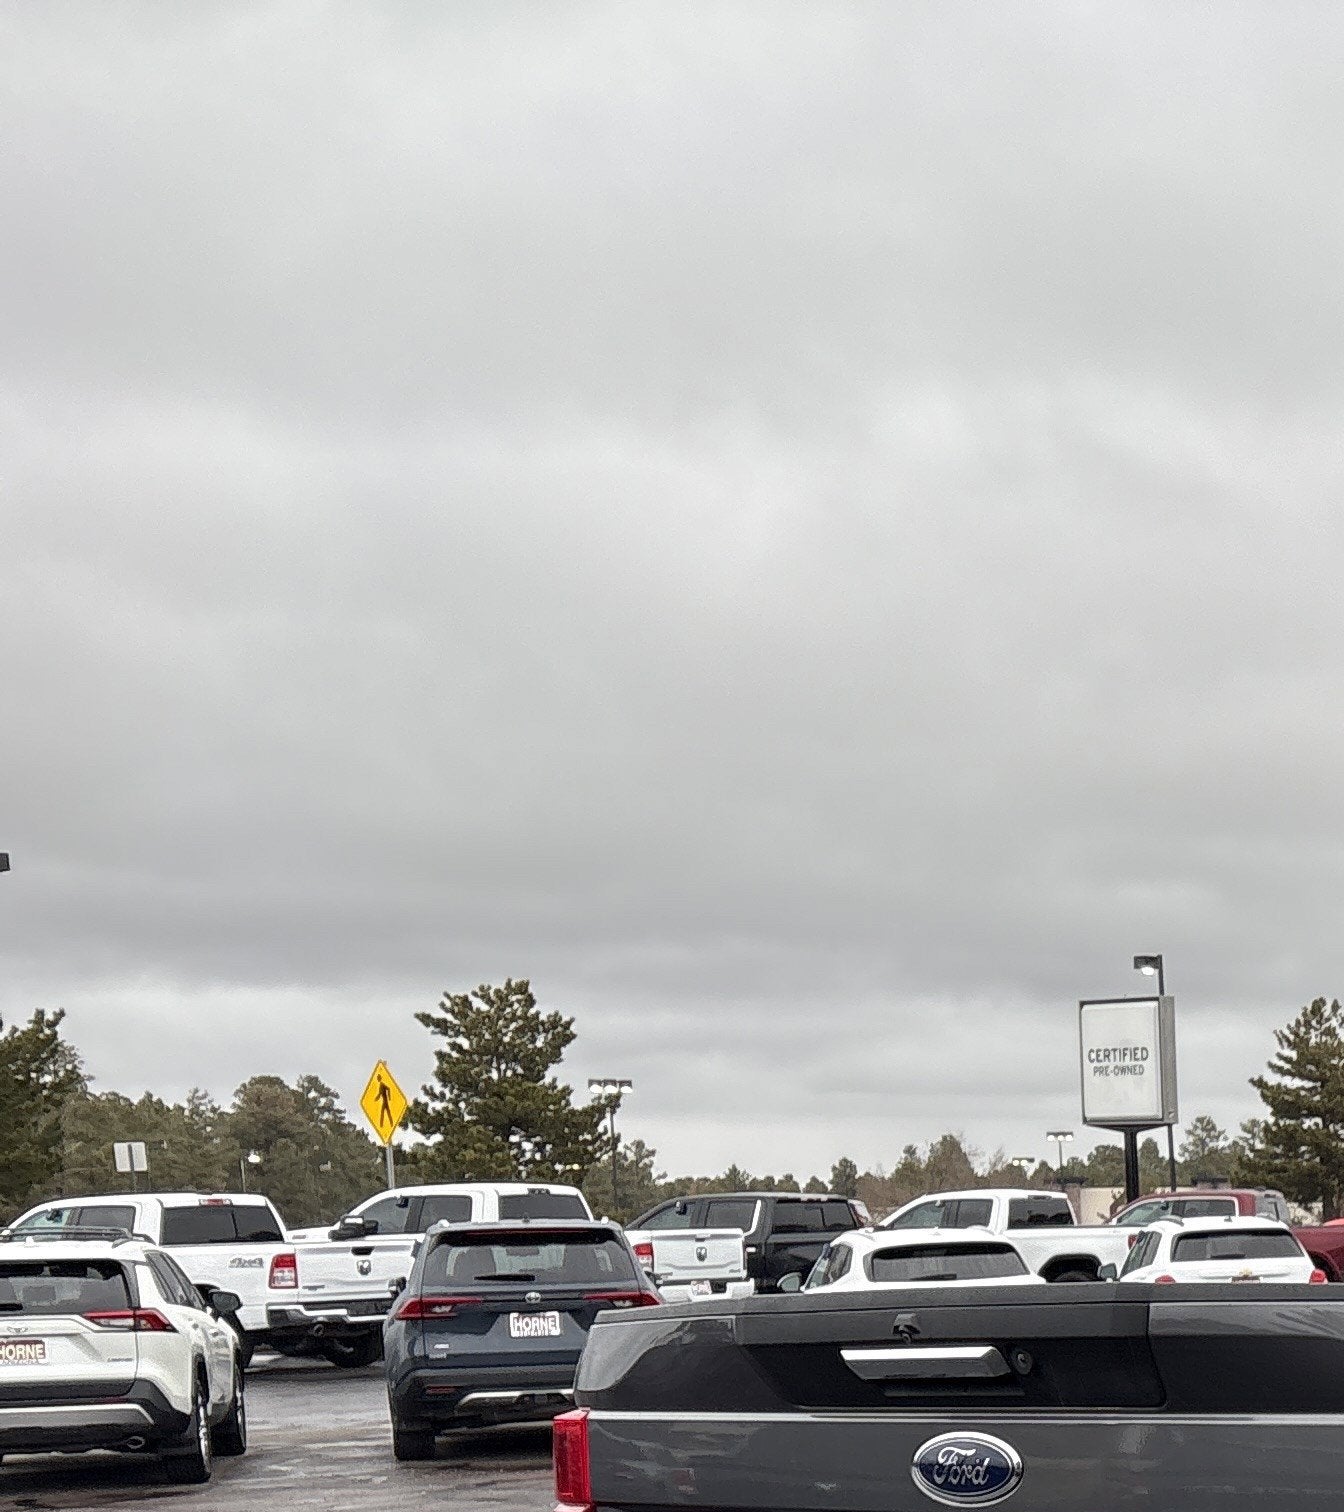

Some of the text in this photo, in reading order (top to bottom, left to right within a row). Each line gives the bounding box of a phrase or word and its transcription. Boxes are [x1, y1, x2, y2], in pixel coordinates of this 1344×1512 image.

[1088, 1046, 1149, 1063] CERTIFIED
[1093, 1064, 1145, 1077] PRE-OWNED
[513, 1317, 557, 1332] HORNE
[933, 1446, 990, 1485] Ford
